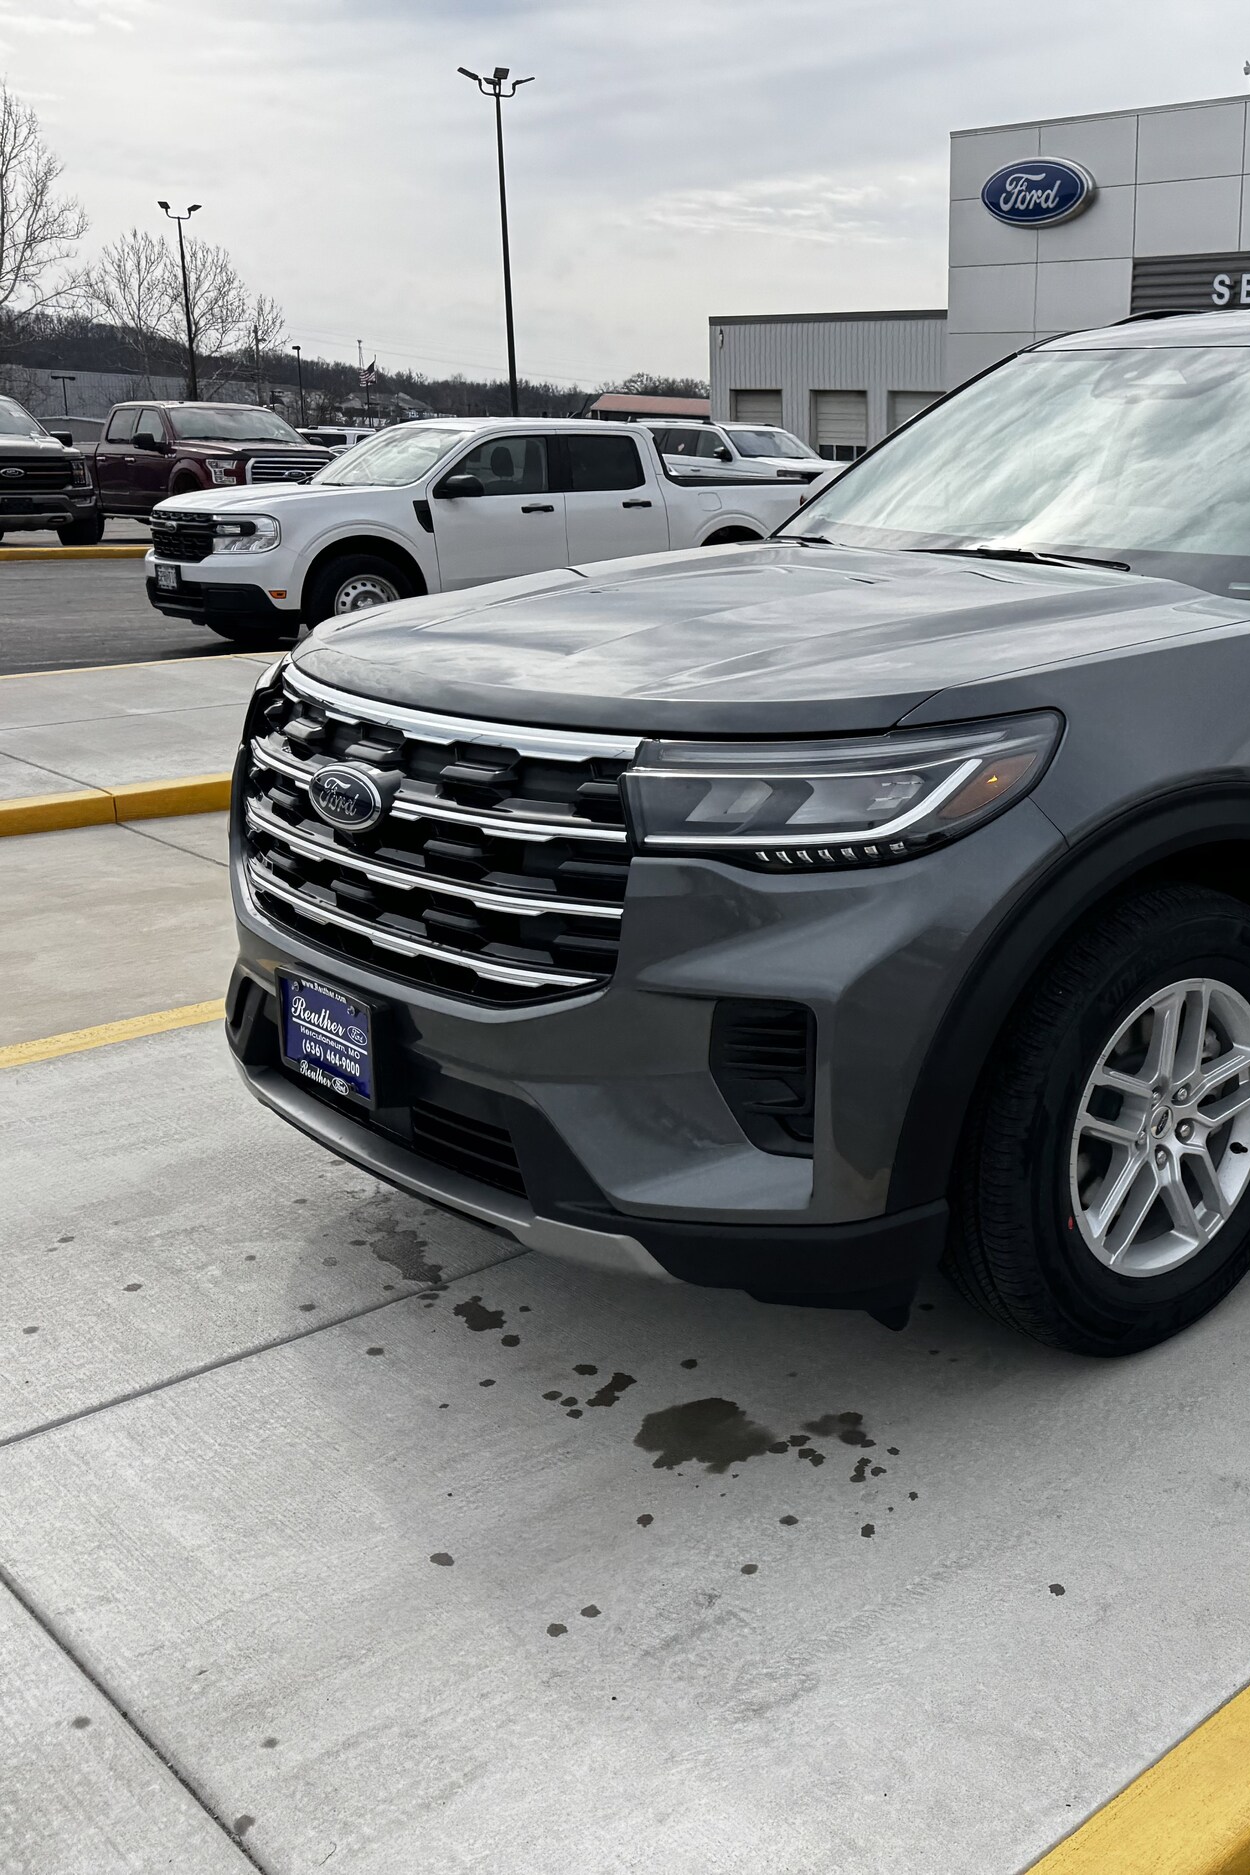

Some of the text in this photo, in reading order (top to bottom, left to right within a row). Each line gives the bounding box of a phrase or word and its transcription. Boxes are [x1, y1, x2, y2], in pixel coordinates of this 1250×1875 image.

[1000, 173, 1061, 212] Ford
[319, 777, 359, 816] Ford
[291, 996, 346, 1036] Reuther
[302, 1038, 360, 1077] (636) 464-9000
[348, 1047, 361, 1060] MO
[300, 1059, 332, 1088] Reuther
